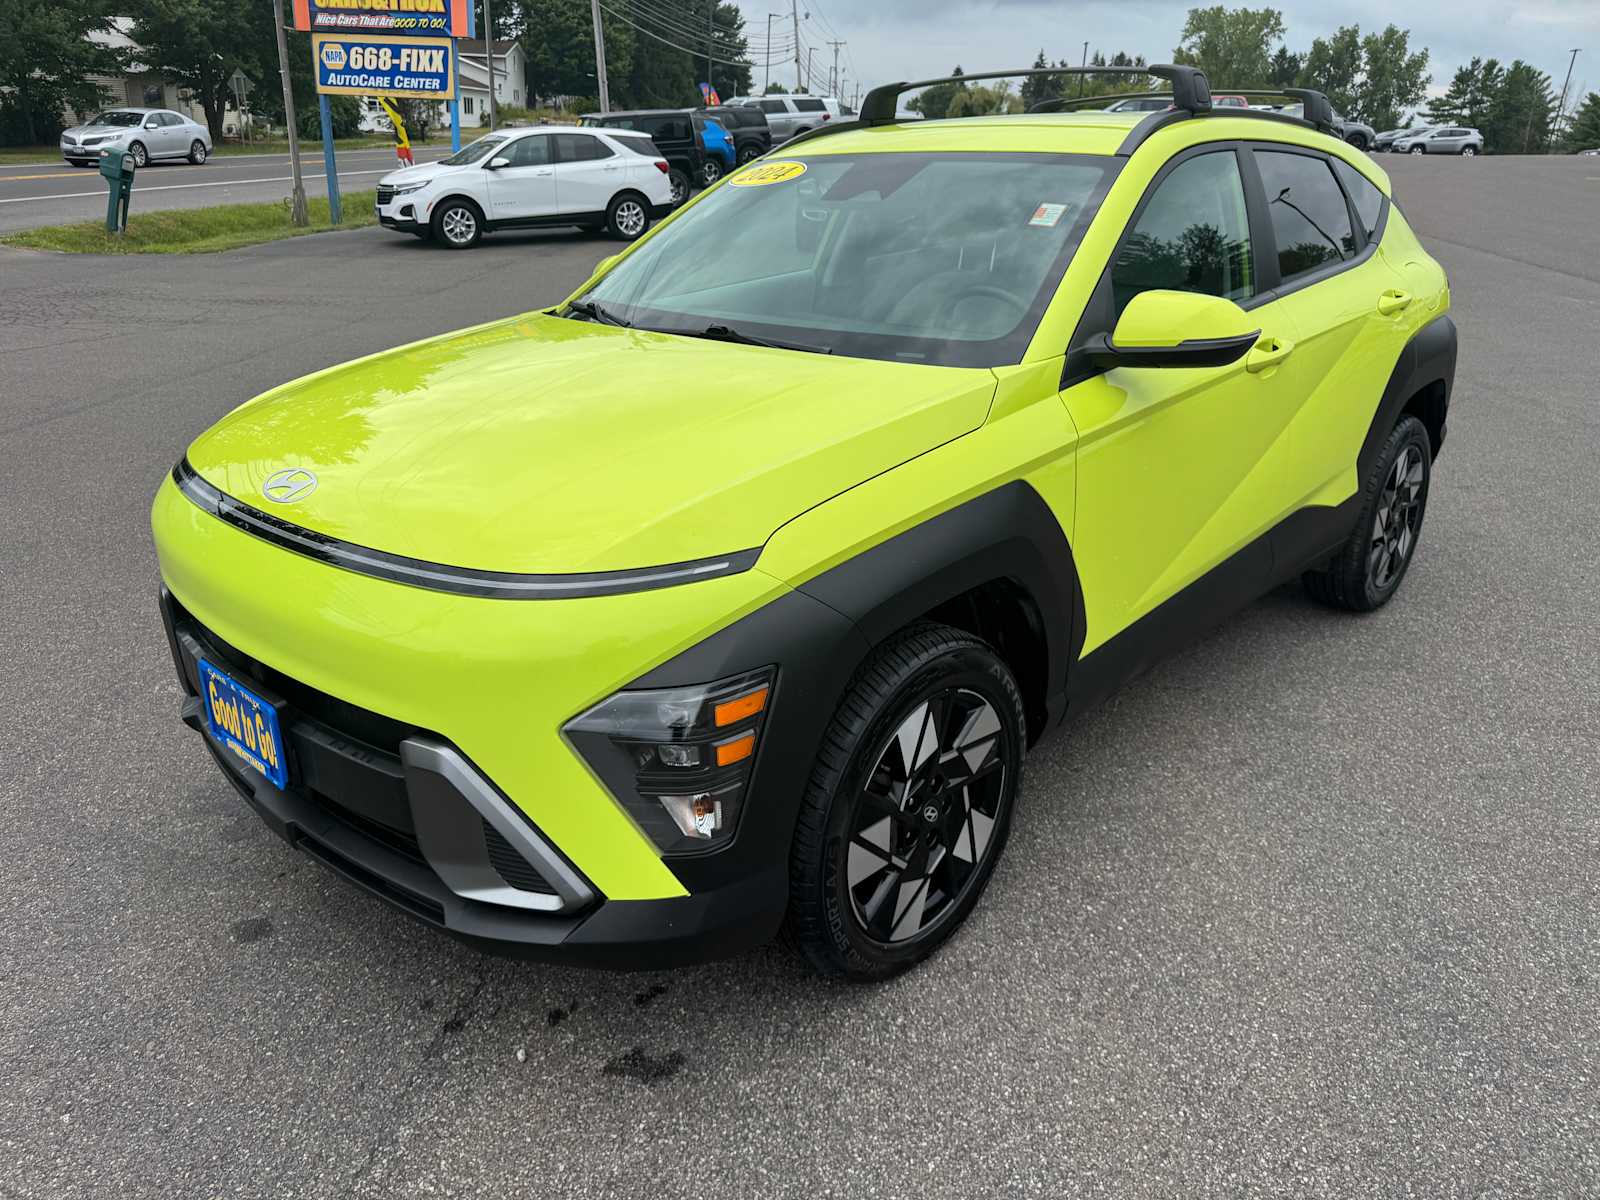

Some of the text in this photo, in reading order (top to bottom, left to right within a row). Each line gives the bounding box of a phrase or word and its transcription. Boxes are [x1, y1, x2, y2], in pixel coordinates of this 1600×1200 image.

[315, 14, 447, 29] Nice Cars That Are GOOD TO GO!
[325, 50, 343, 62] NAPA
[349, 46, 445, 73] 668-FIXX
[209, 680, 242, 741] Good
[240, 703, 256, 752] to
[255, 713, 278, 769] Go!
